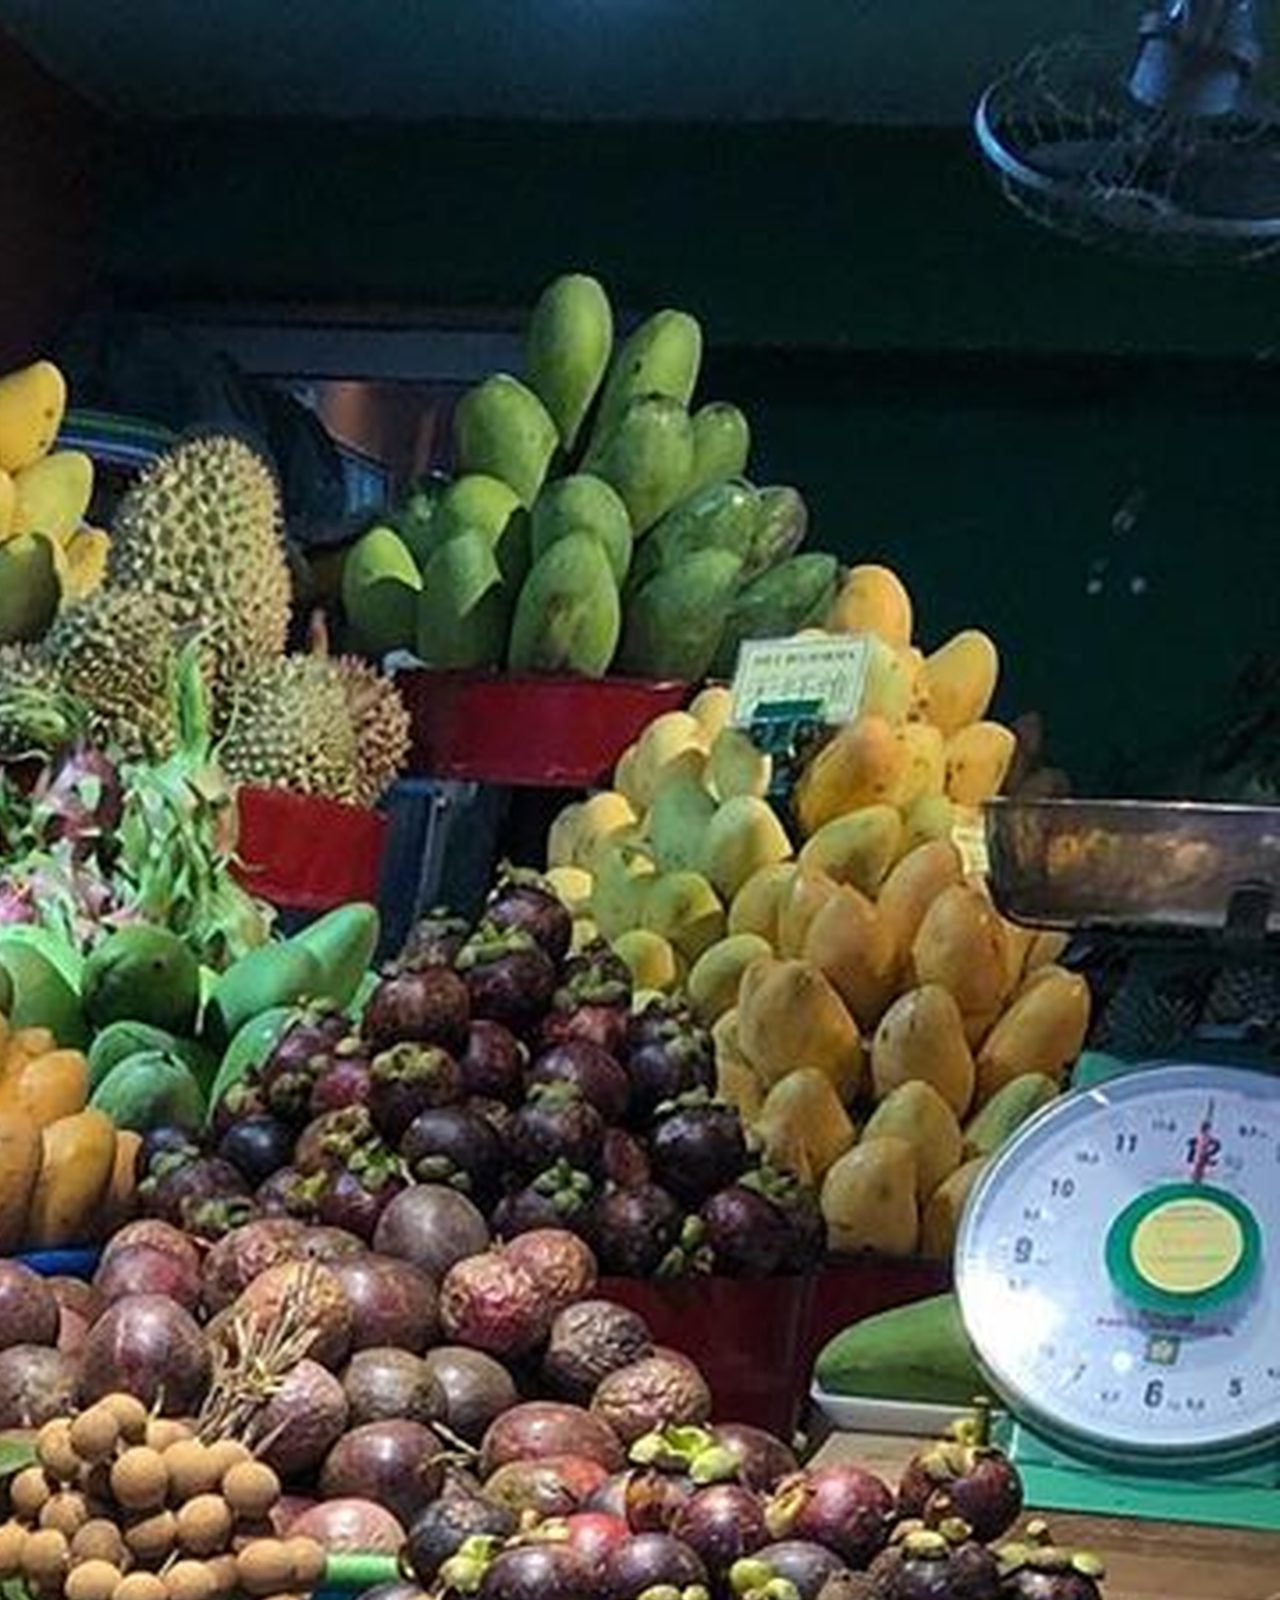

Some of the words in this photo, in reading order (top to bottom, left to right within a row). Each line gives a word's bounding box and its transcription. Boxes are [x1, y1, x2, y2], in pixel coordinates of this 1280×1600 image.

[1116, 1134, 1138, 1153] 11
[1186, 1138, 1223, 1165] 12
[1051, 1180, 1074, 1198] 10
[1144, 1379, 1164, 1408] 6
